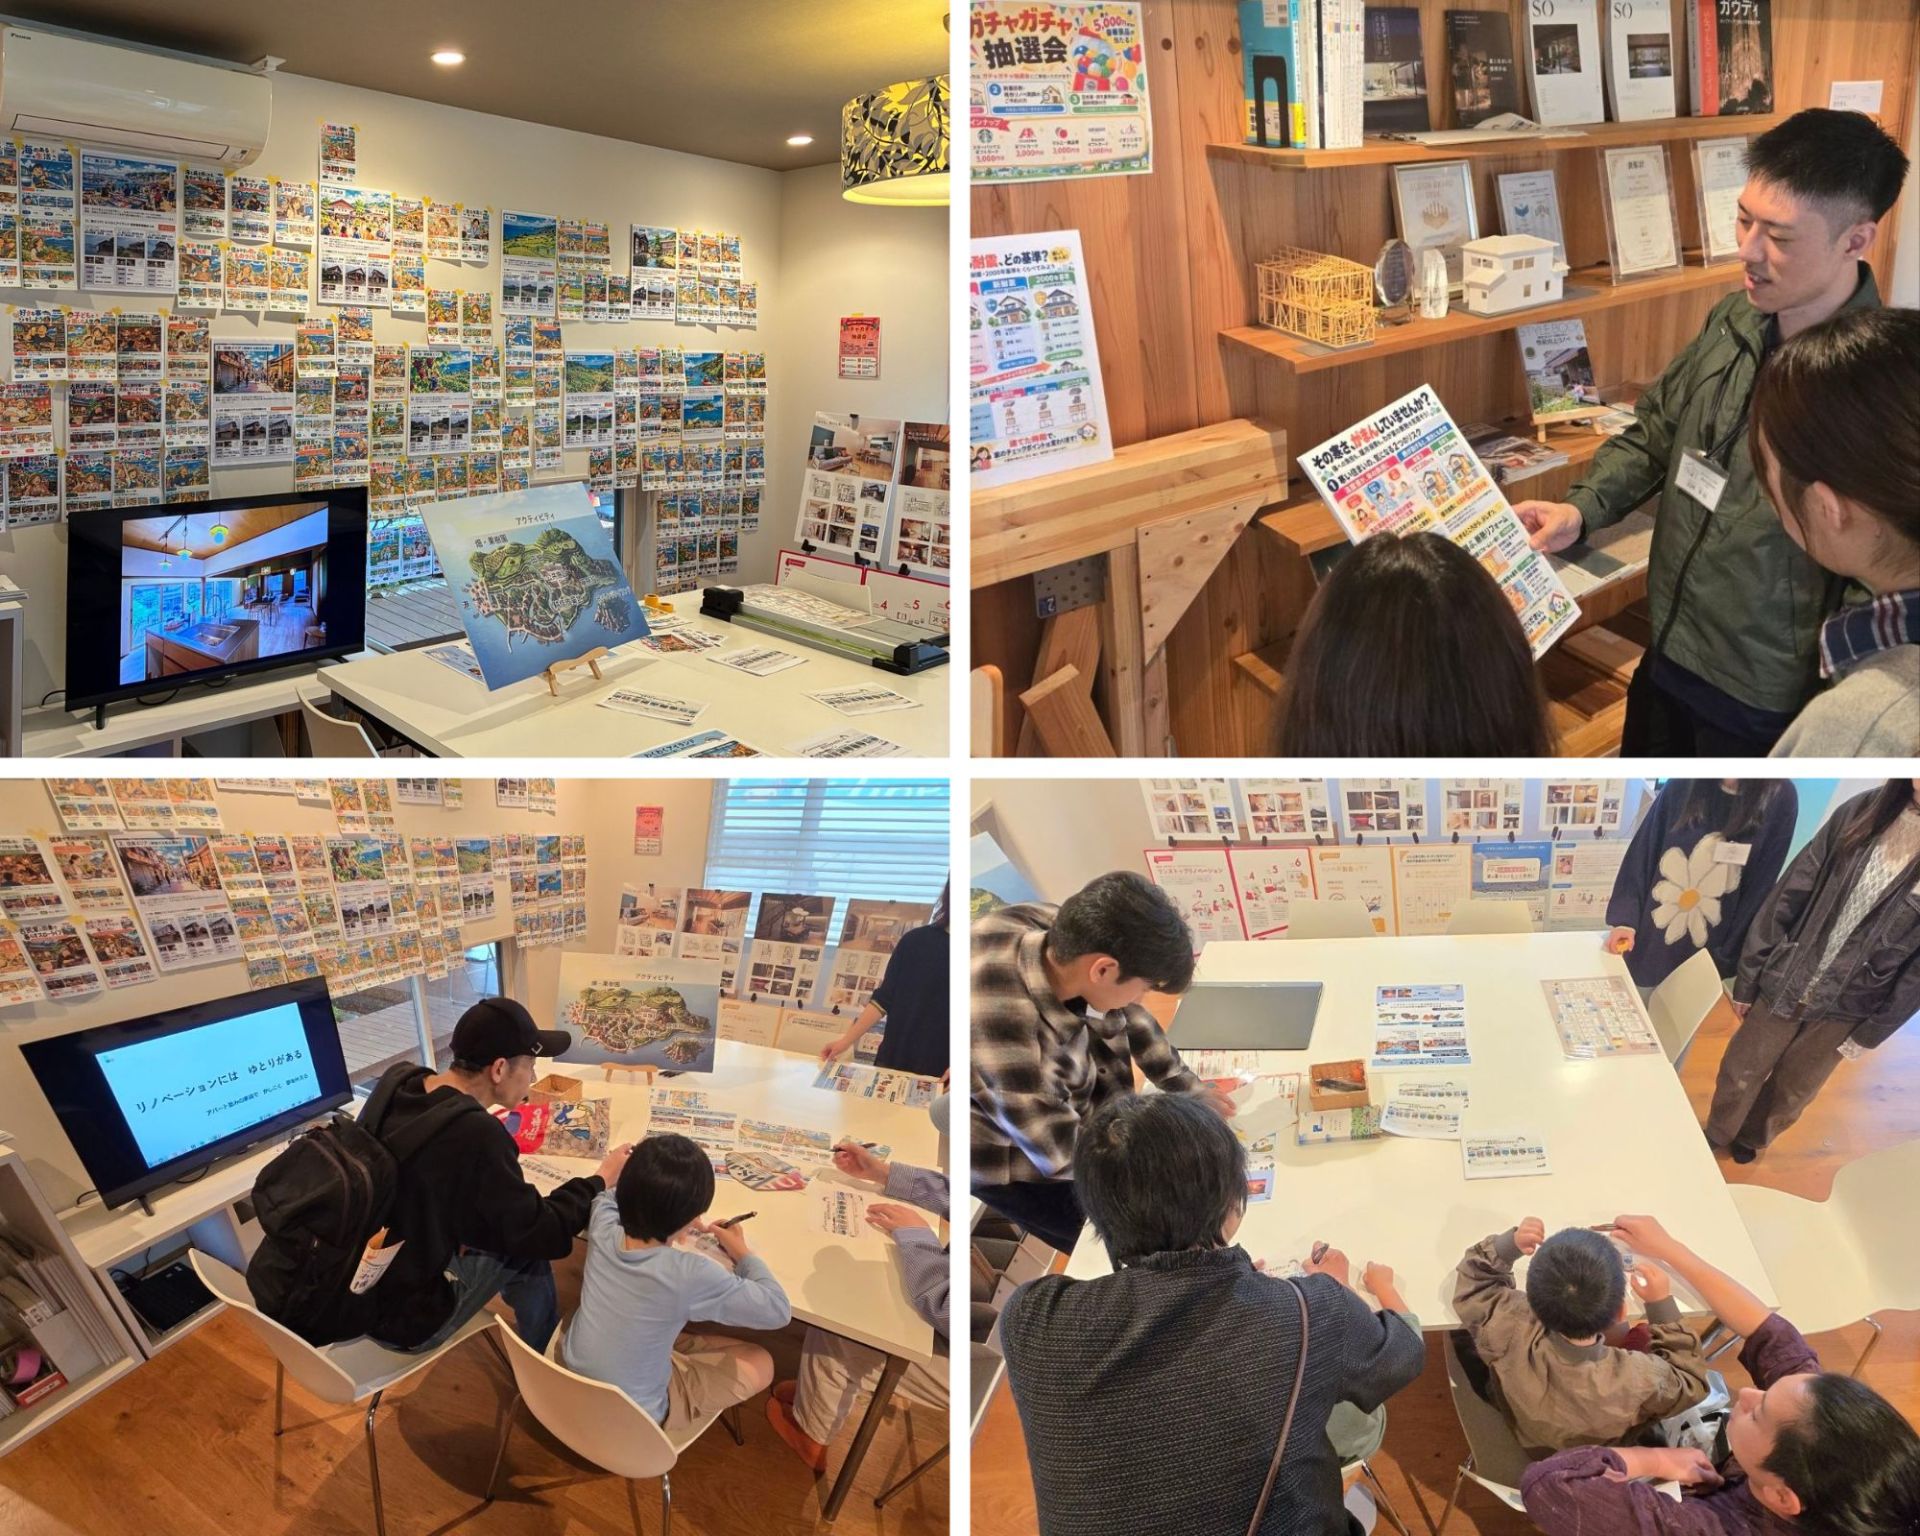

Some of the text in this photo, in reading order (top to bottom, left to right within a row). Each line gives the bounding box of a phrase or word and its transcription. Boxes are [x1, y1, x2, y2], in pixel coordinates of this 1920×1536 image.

[1718, 0, 1760, 18] ガウディ
[970, 7, 1073, 39] ガチャガチャ
[982, 36, 1068, 70] 抽選会
[970, 249, 1049, 269] 耐震、どの基準?
[1311, 391, 1432, 470] その寒さ、がまんしていませんか?
[1337, 428, 1422, 484] 寒い住まいの、気になる2つのリスク
[515, 512, 555, 525] アクティビティ
[880, 600, 888, 610] 4
[912, 599, 920, 610] 5
[1295, 856, 1303, 867] 6
[1248, 865, 1279, 881] 4 5
[1218, 883, 1225, 893] 3
[135, 1049, 303, 1114] リノベーションには ゆとりがある
